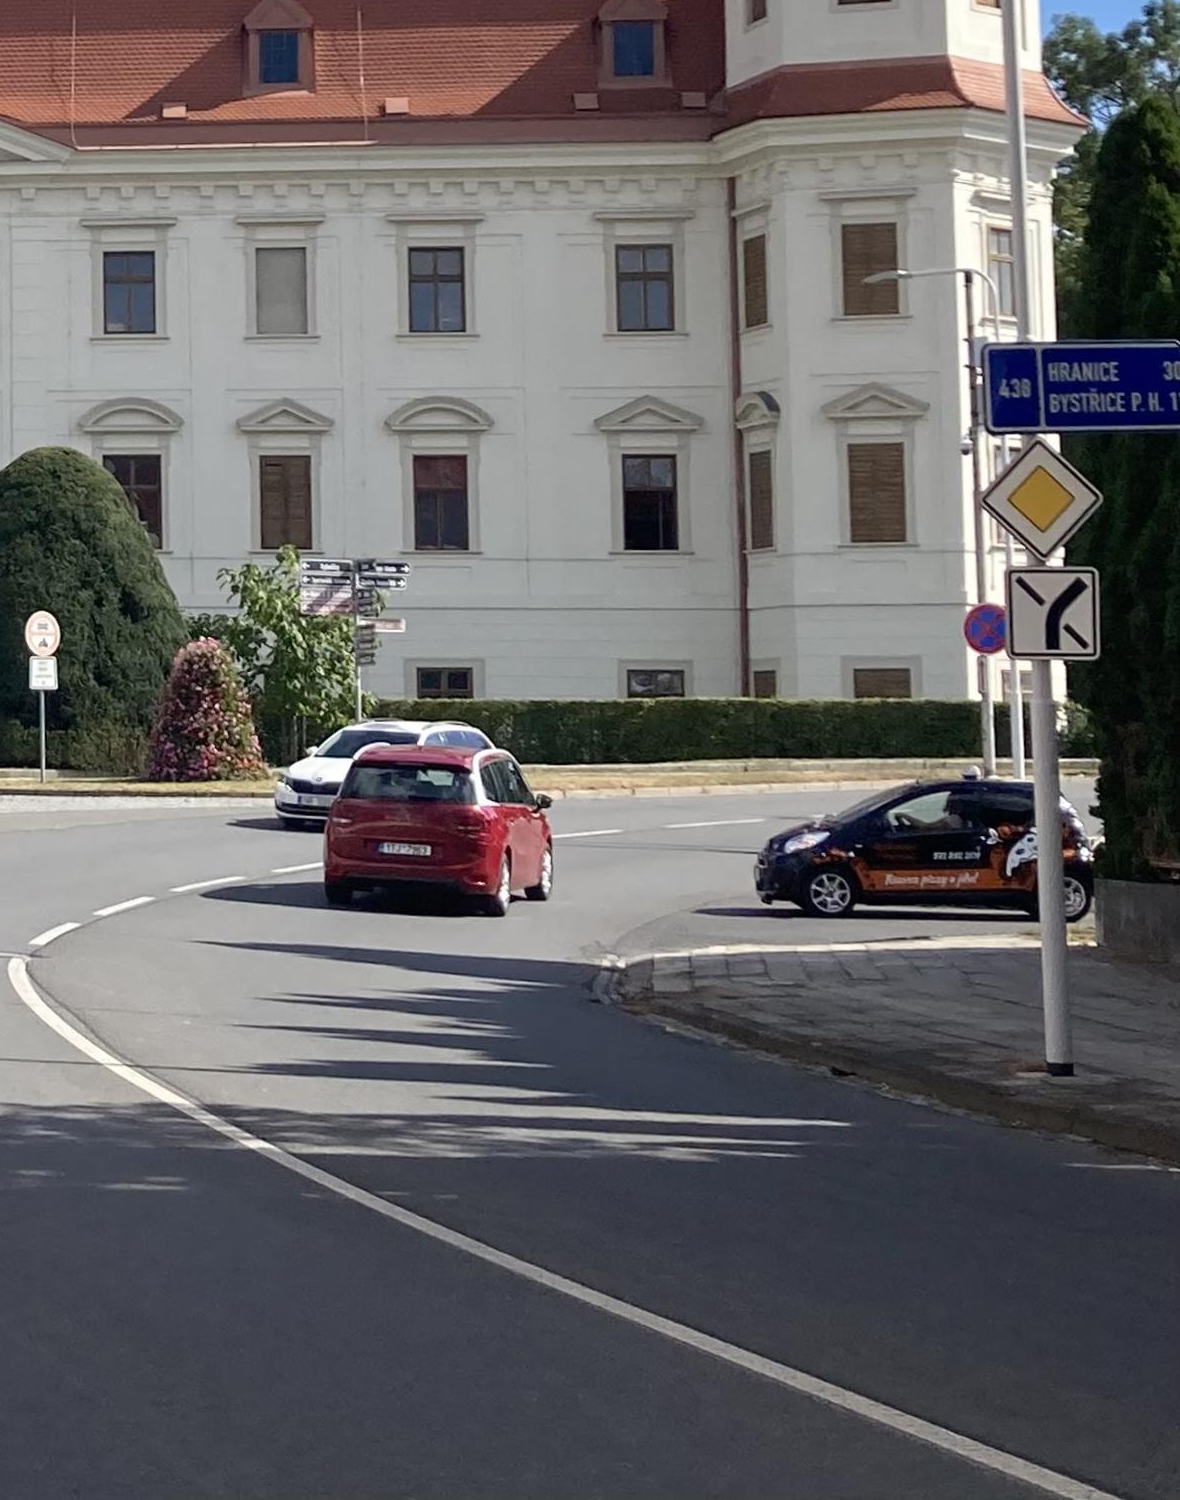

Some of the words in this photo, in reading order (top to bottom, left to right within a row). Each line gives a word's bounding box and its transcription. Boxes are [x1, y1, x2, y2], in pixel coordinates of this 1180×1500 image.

[1048, 361, 1120, 382] HRANICE
[999, 378, 1032, 398] 438
[1049, 387, 1126, 413] BYSTŘICE
